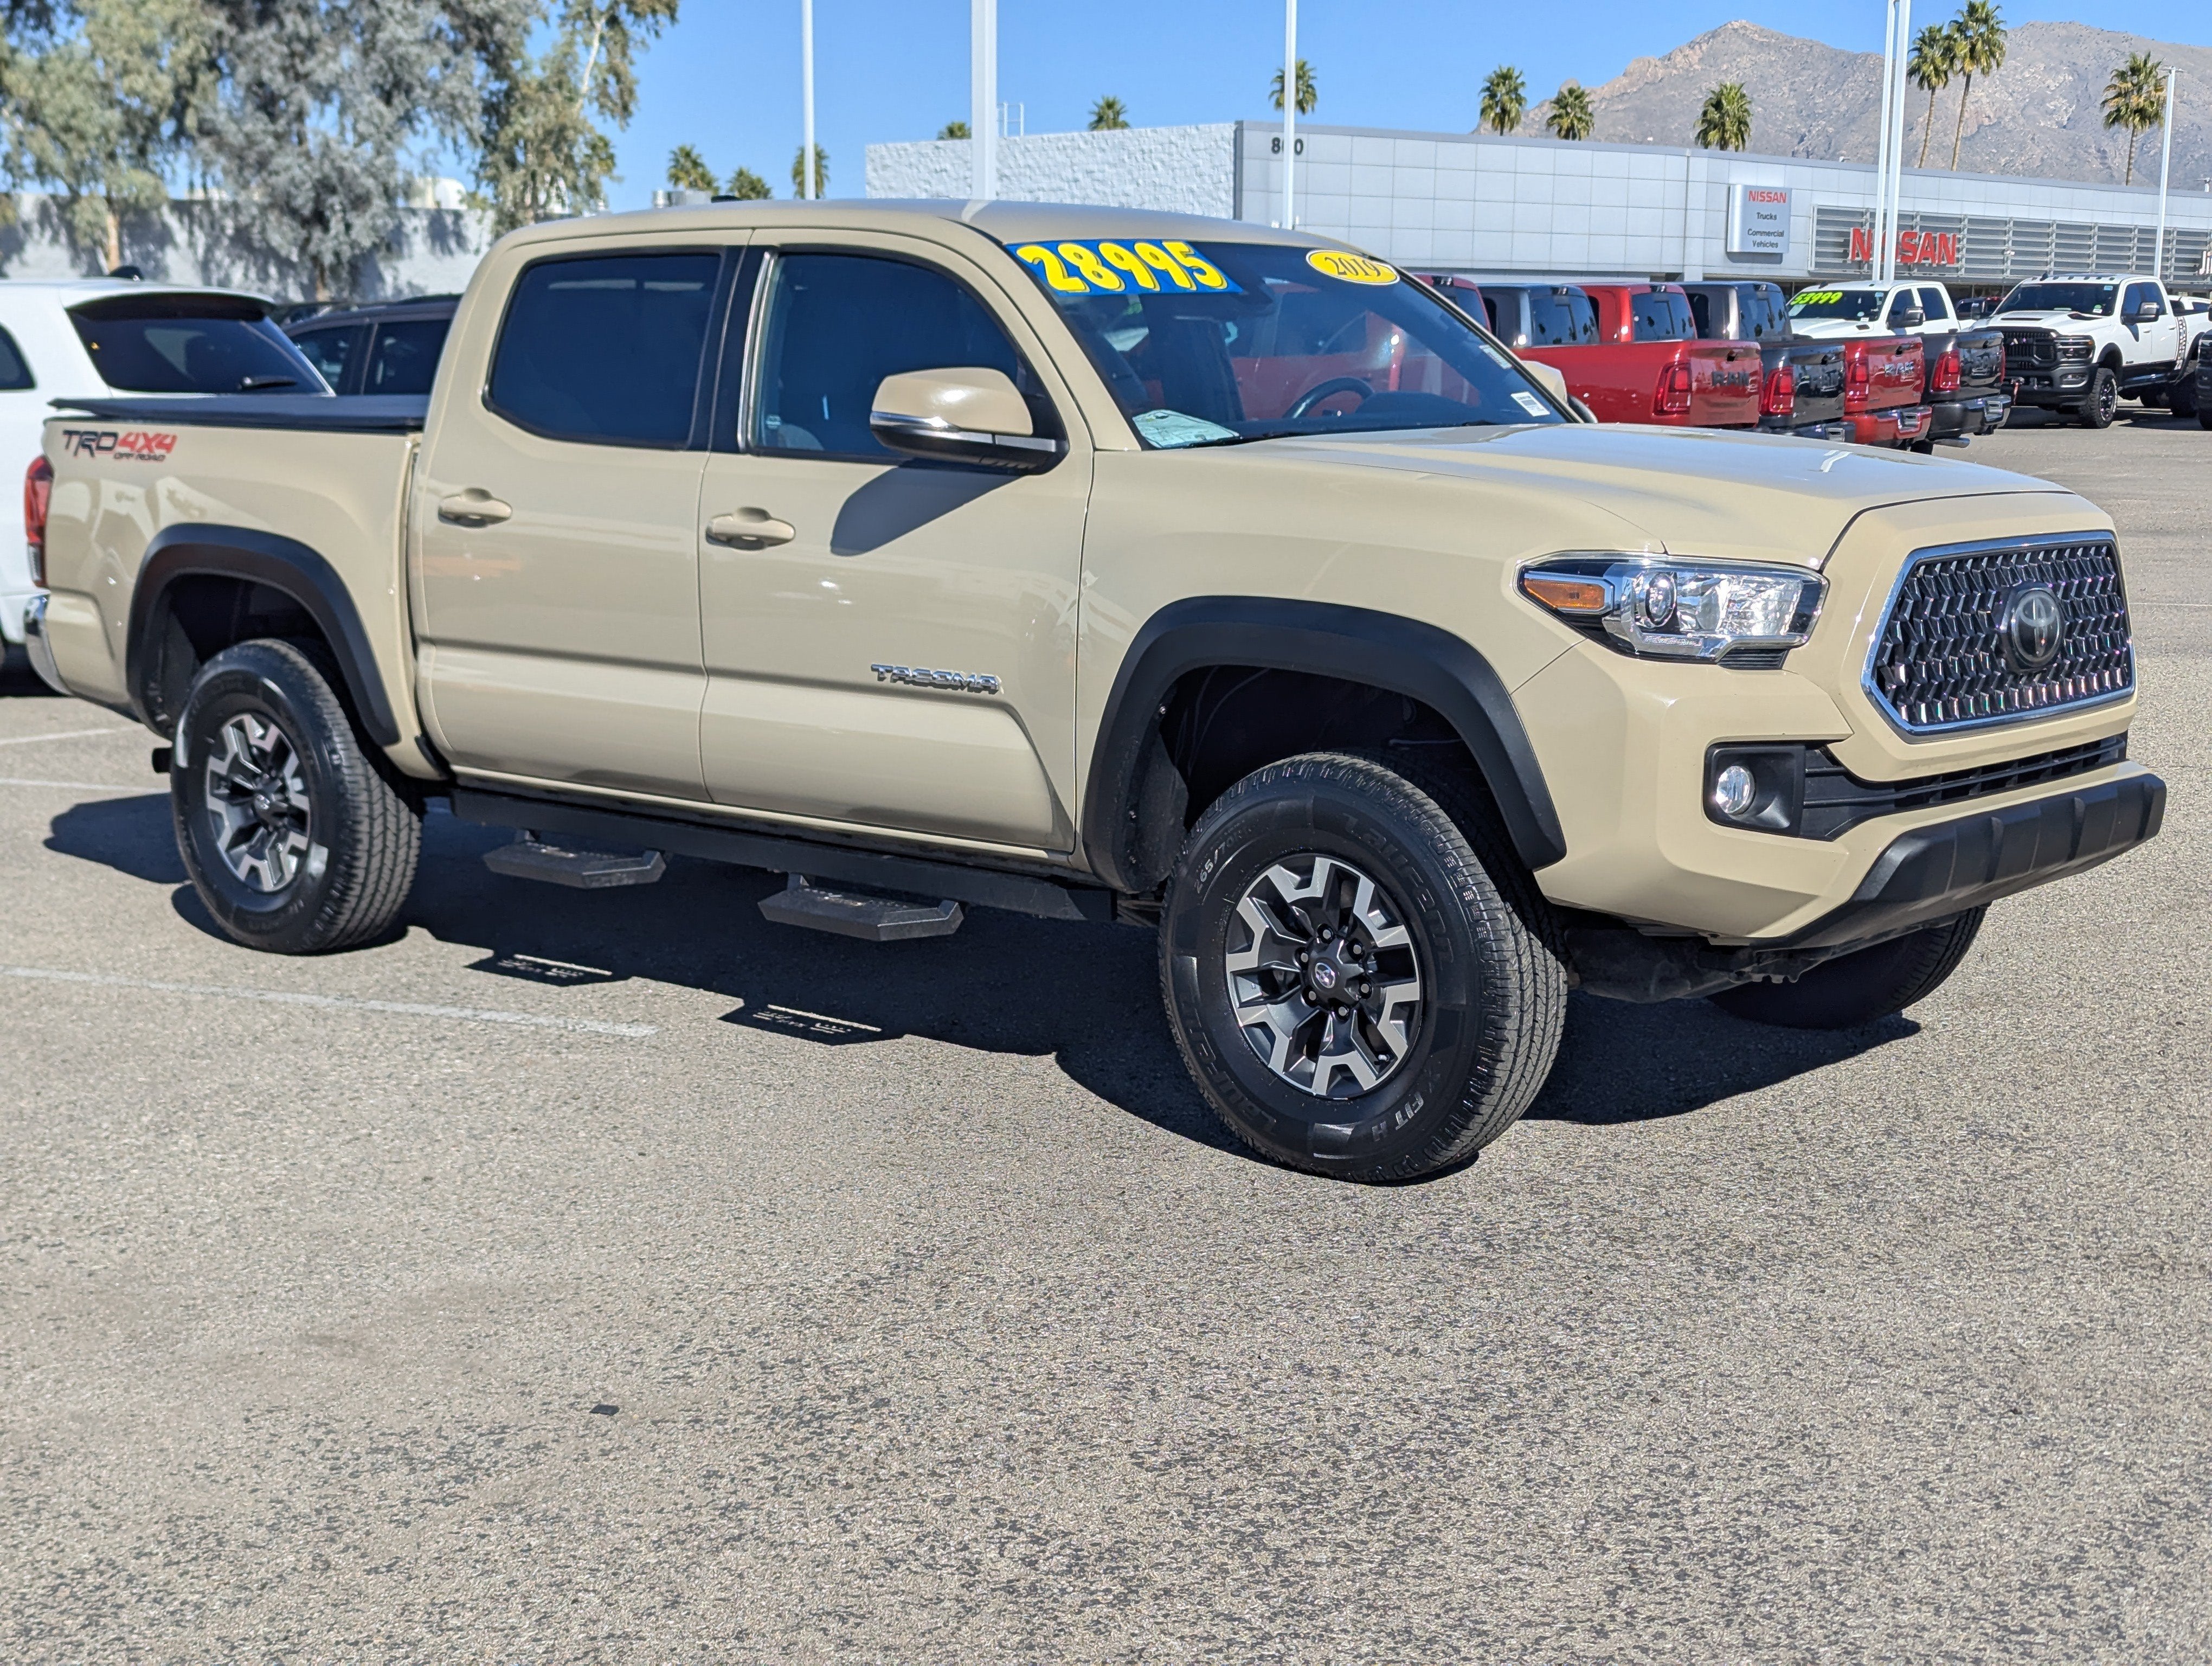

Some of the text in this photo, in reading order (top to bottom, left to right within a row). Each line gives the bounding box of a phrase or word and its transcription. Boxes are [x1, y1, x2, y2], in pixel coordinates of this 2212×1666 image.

[1271, 137, 1303, 155] 80
[1748, 190, 1786, 203] NISSAN
[1756, 212, 1777, 220] Trucks
[1747, 228, 1784, 237] Commercial
[1752, 240, 1779, 248] Vehicles
[1849, 228, 1957, 265] NSAN
[1017, 241, 1227, 292] 28995
[1324, 257, 1381, 277] 2019
[1791, 292, 1843, 305] 53999
[1885, 361, 1914, 377] RAM
[1712, 370, 1750, 387] RAM
[63, 430, 119, 458] TRD
[871, 663, 1002, 695] TACOMA
